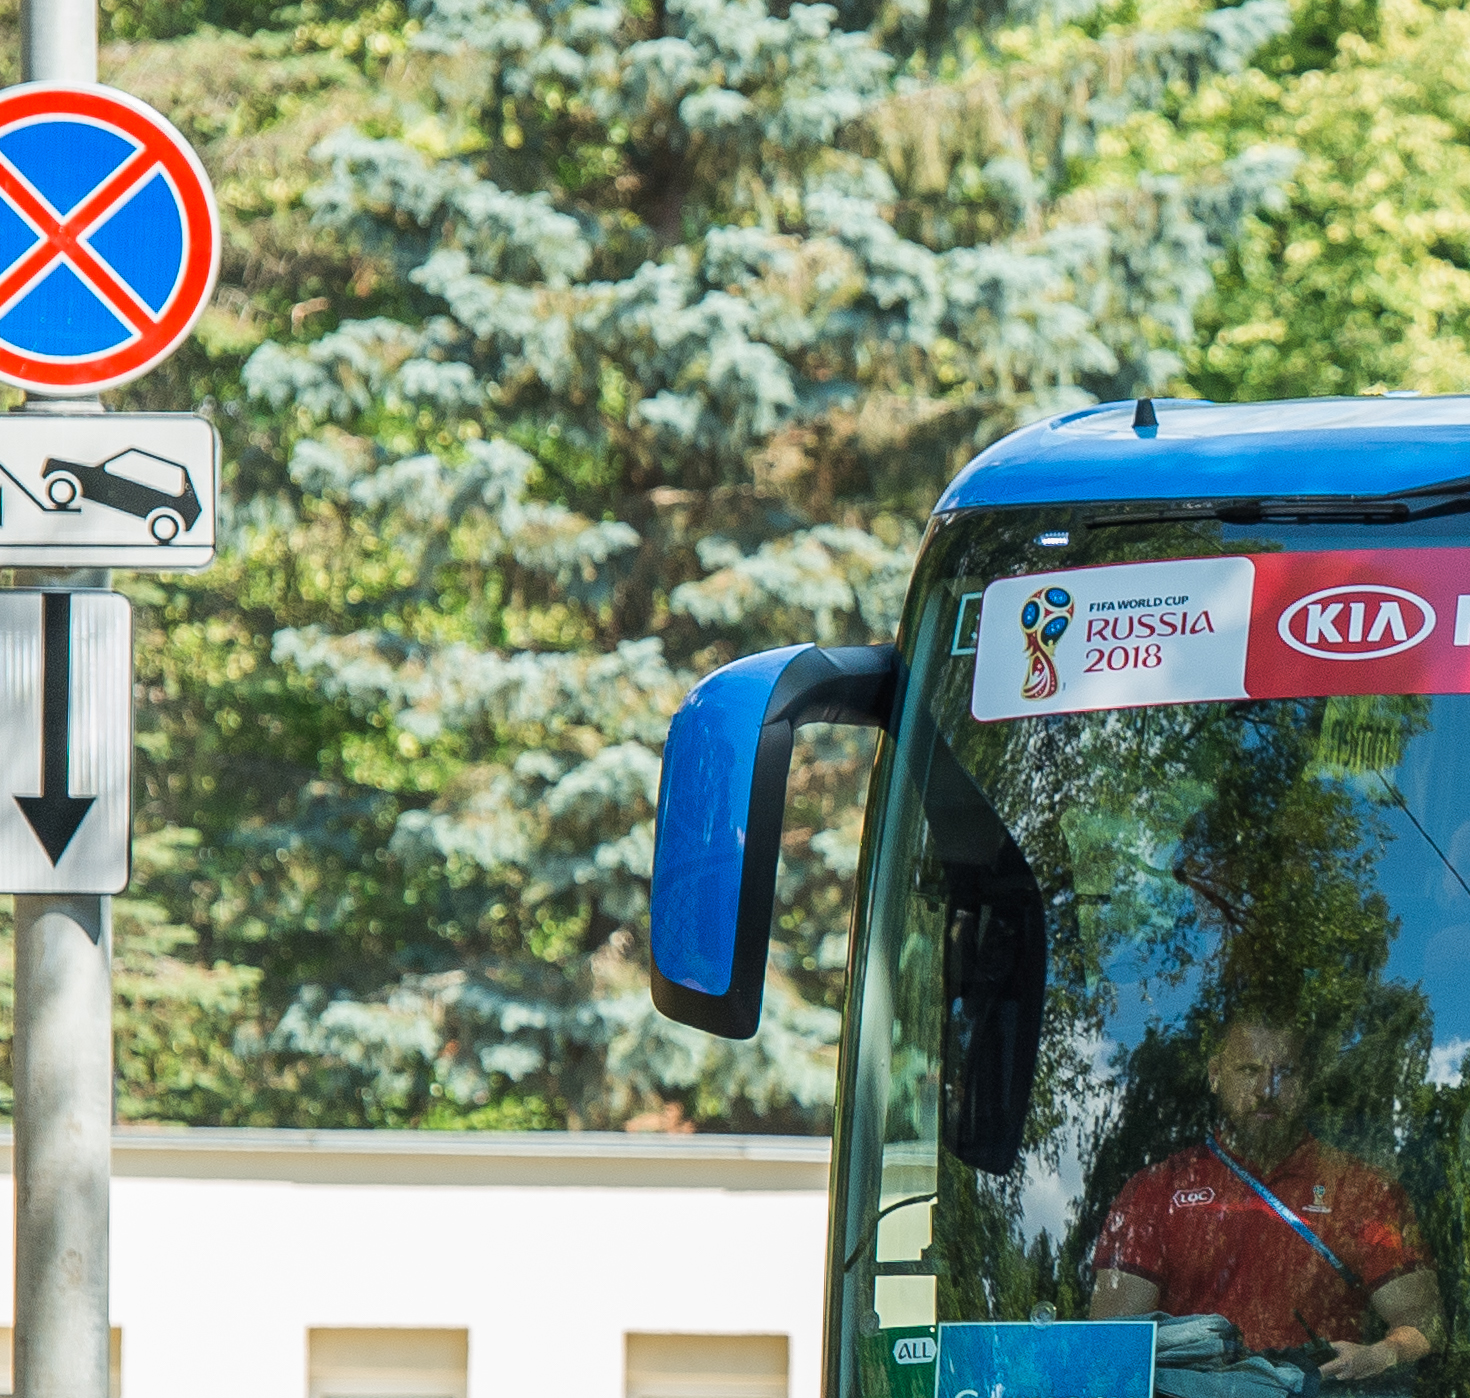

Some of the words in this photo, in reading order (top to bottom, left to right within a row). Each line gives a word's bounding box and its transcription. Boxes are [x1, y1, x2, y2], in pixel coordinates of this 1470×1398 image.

[1089, 602, 1115, 612] FIFA
[1118, 597, 1163, 610] WORLD
[1165, 595, 1189, 606] CUP
[1086, 610, 1215, 642] RUSSIA
[1305, 602, 1407, 644] KIA
[1083, 643, 1162, 673] 2018
[897, 1343, 933, 1360] ALL
